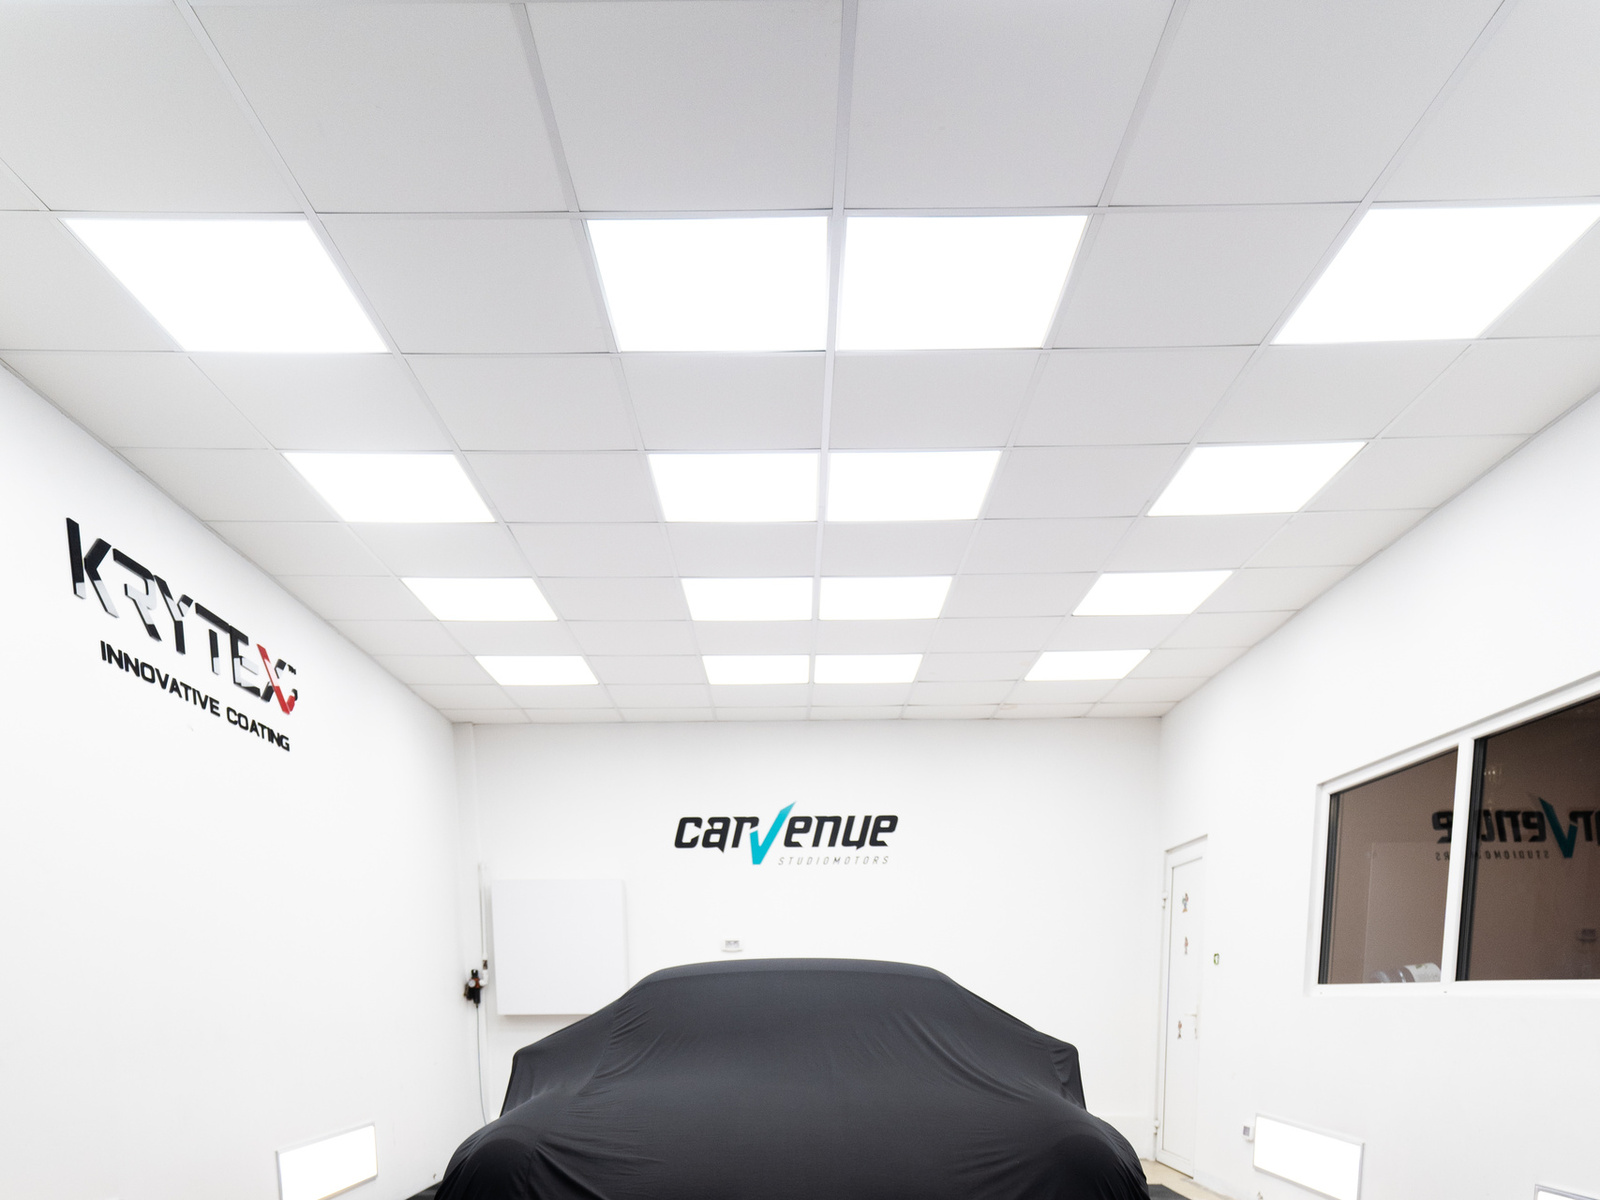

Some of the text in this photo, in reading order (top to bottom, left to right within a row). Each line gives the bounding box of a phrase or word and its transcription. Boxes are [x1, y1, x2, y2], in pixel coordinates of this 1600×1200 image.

[66, 517, 298, 715] KRYTEX
[100, 640, 290, 752] INNOVATIVE COATING
[778, 855, 889, 866] STUDIOMOTORS
